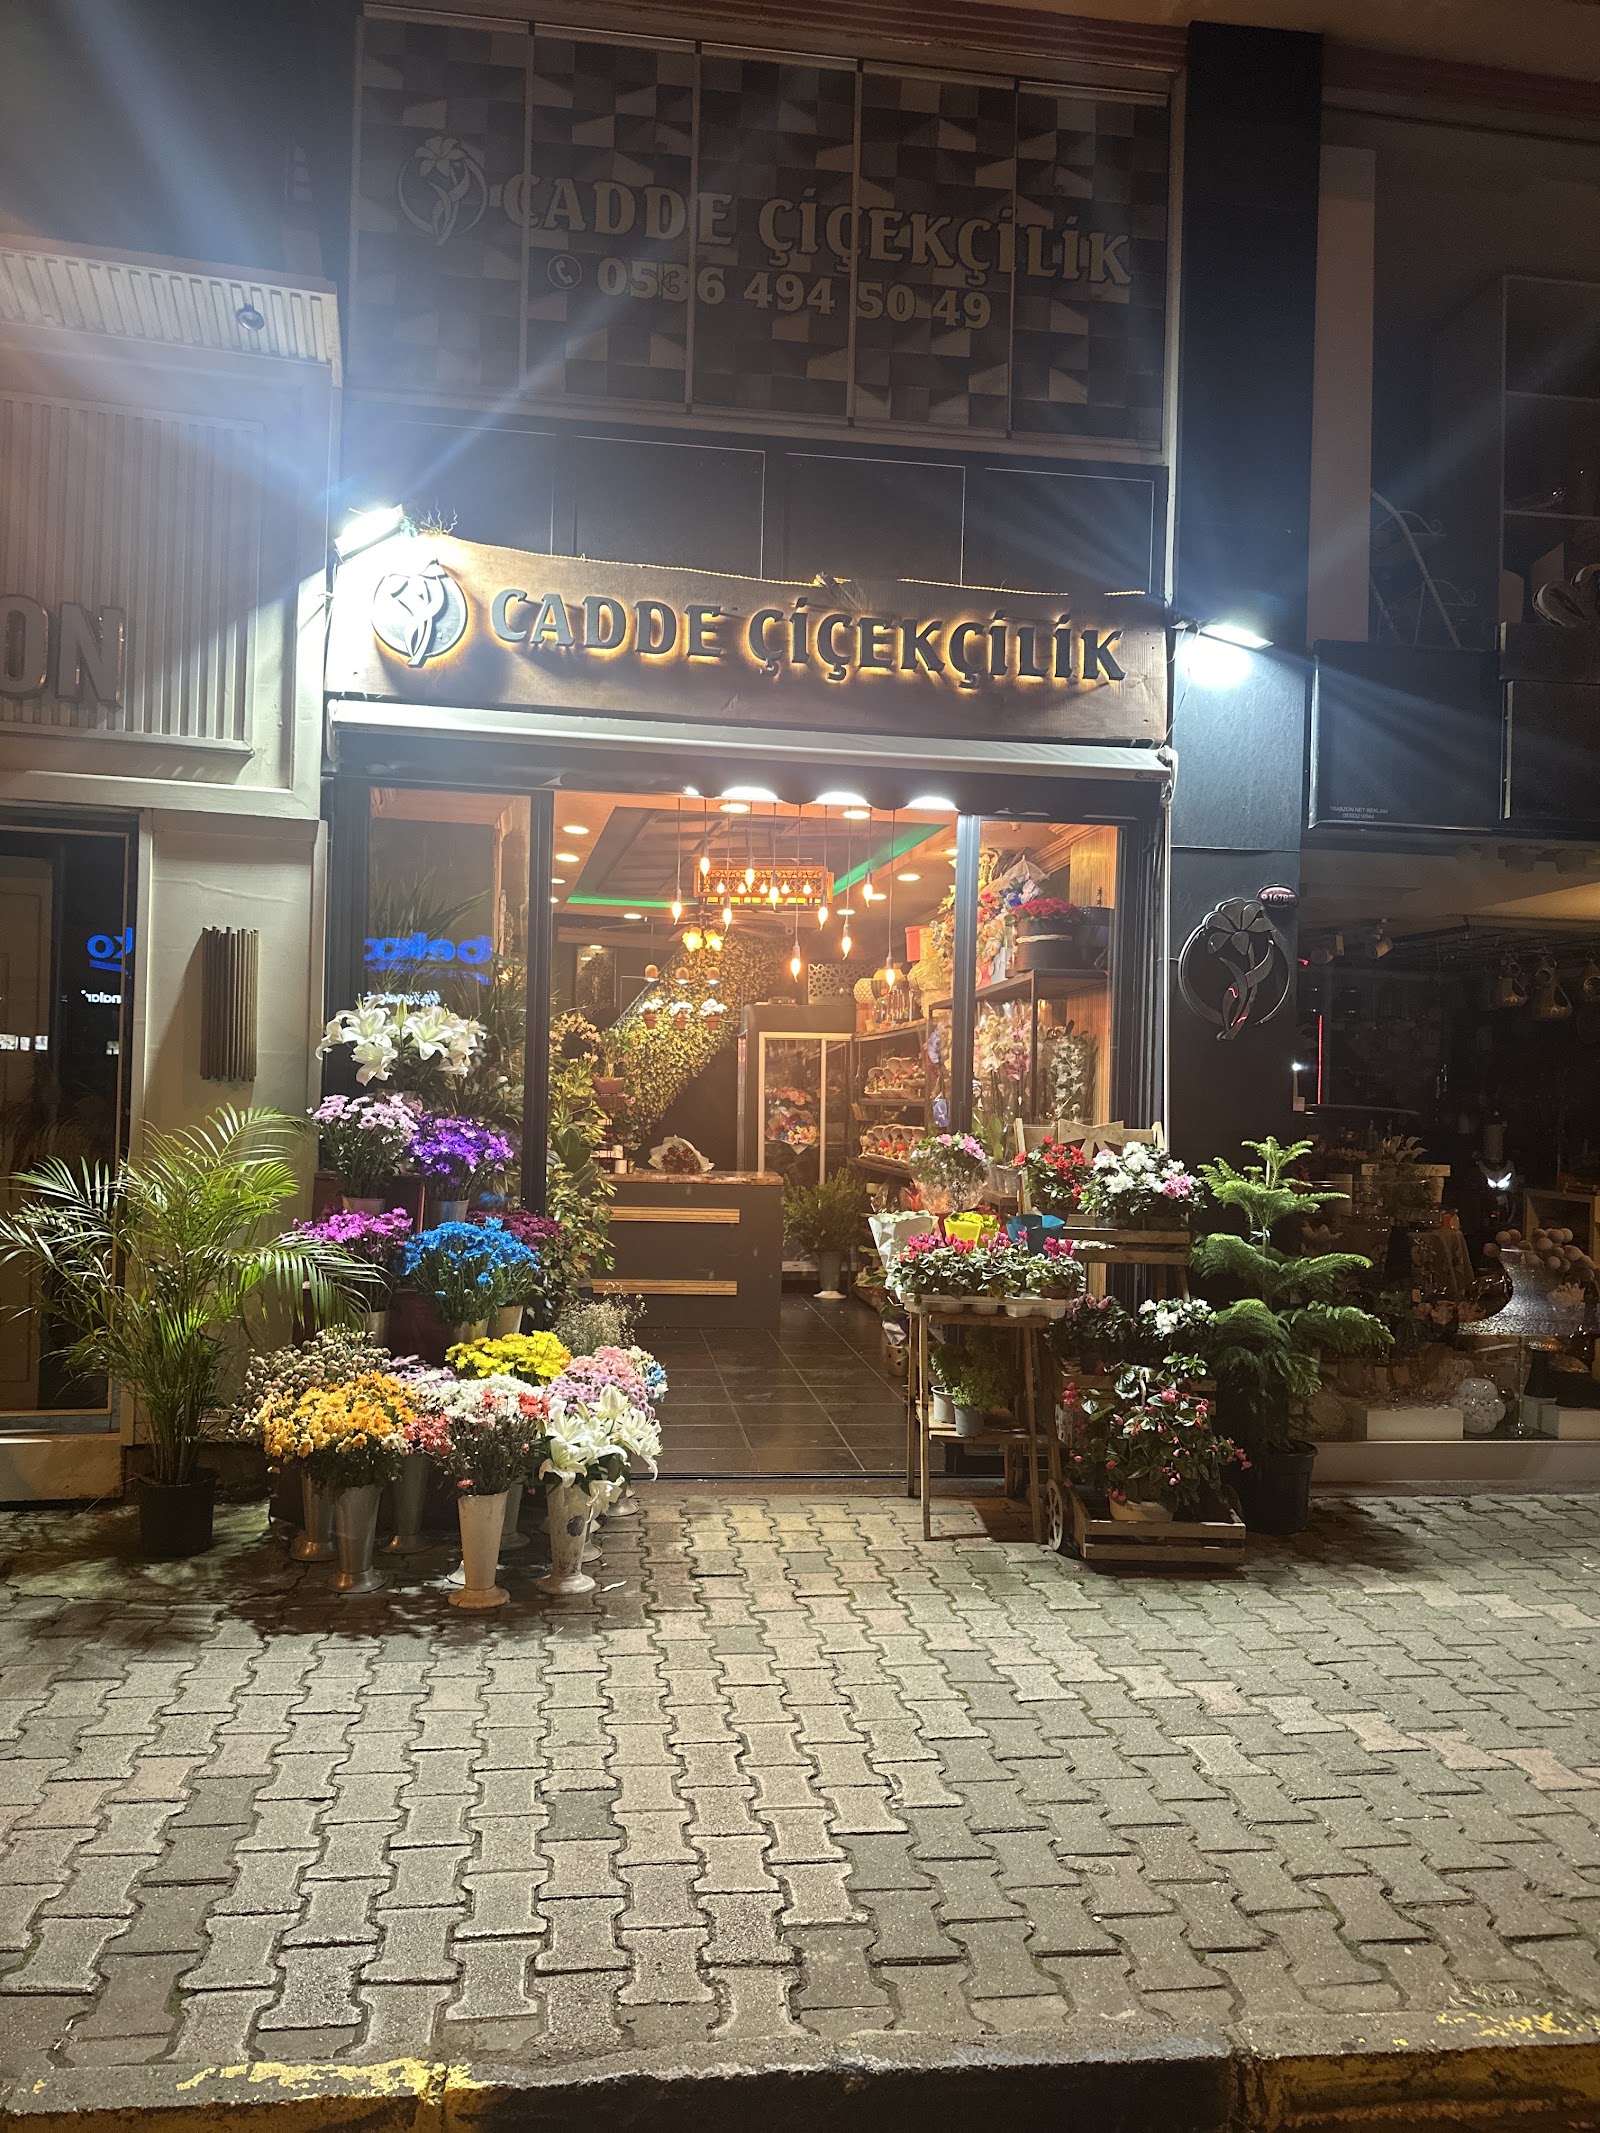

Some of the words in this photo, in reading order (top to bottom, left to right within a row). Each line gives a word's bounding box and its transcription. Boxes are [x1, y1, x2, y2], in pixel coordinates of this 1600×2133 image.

[502, 172, 732, 246] CADDE
[758, 188, 1132, 286] ÇİÇEKÇİLİK
[597, 257, 726, 304] 0536
[744, 271, 835, 315] 494
[857, 281, 917, 322] 50
[932, 291, 992, 330] 49
[491, 588, 722, 657] CADDE
[748, 597, 1128, 689] ÇİÇEKÇİLİK
